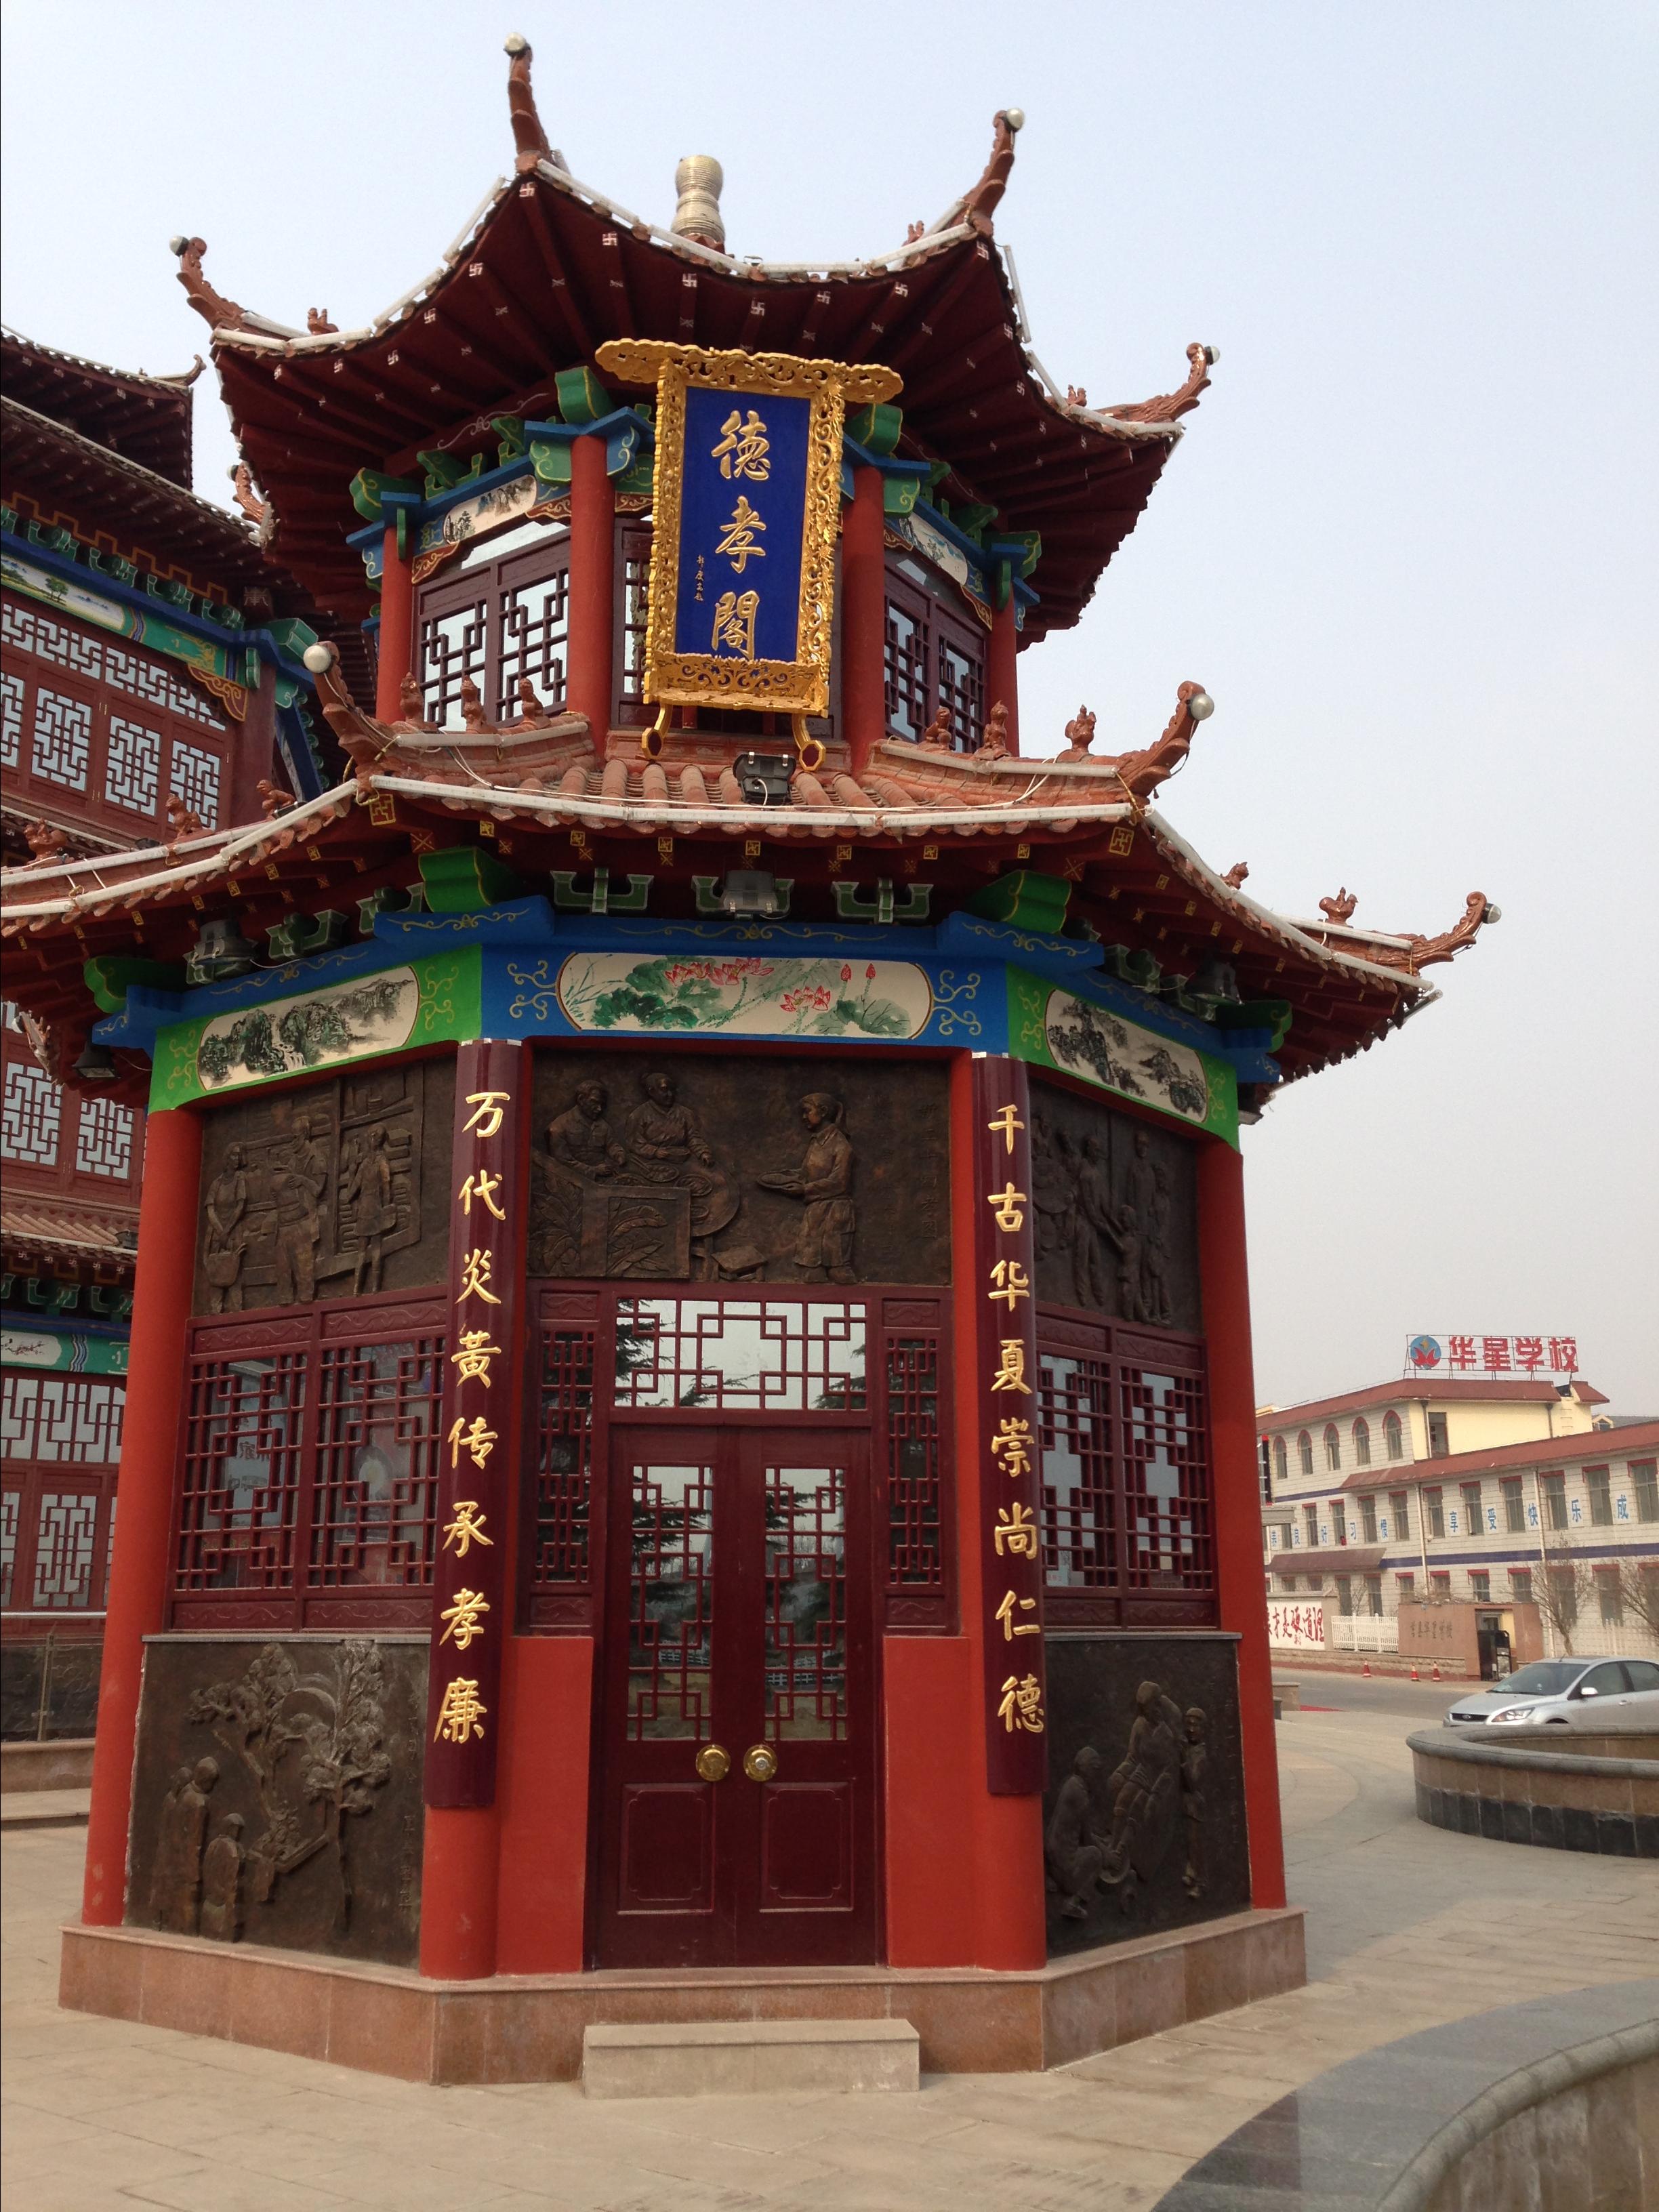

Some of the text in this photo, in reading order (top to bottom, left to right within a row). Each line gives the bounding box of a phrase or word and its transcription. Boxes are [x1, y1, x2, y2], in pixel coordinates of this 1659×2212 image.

[1448, 1336, 1579, 1372] 华星学校
[1267, 1605, 1325, 1643] 才是硬道理
